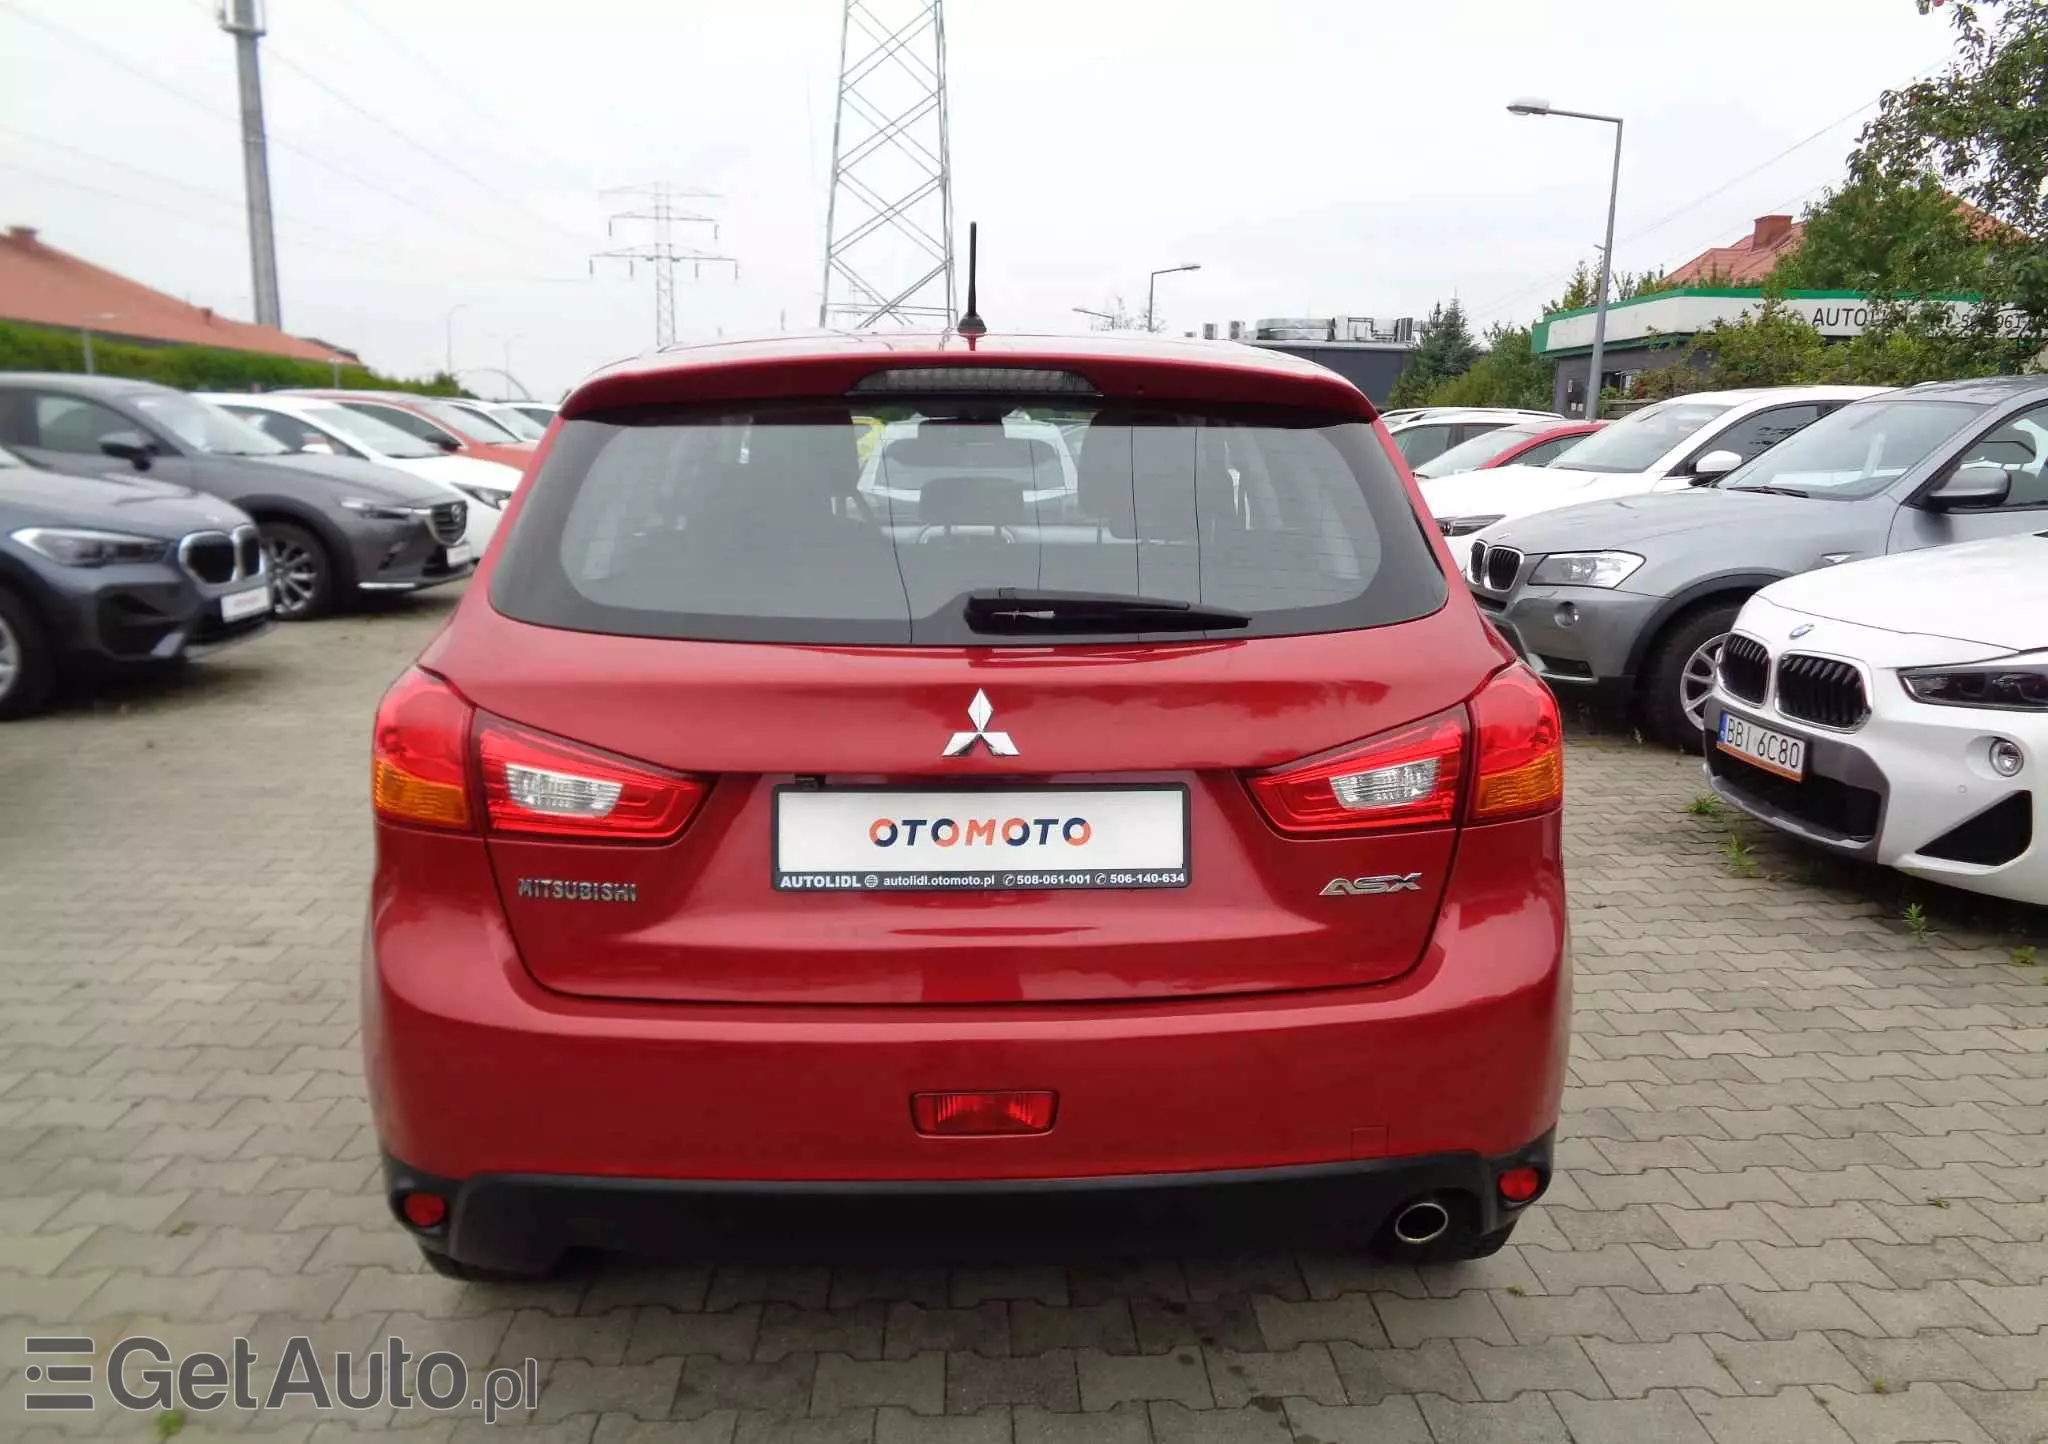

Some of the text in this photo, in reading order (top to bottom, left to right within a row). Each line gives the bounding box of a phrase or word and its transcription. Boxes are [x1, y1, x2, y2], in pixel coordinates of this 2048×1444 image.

[1727, 718, 1800, 768] BBI 6C80
[869, 817, 1092, 848] OTOMOTO
[518, 878, 637, 902] MITSUBISHI
[780, 873, 1185, 888] AUTOLIDL autolidl.otomoto.pl 508-061-001 506-140-634
[1318, 872, 1422, 896] ASX
